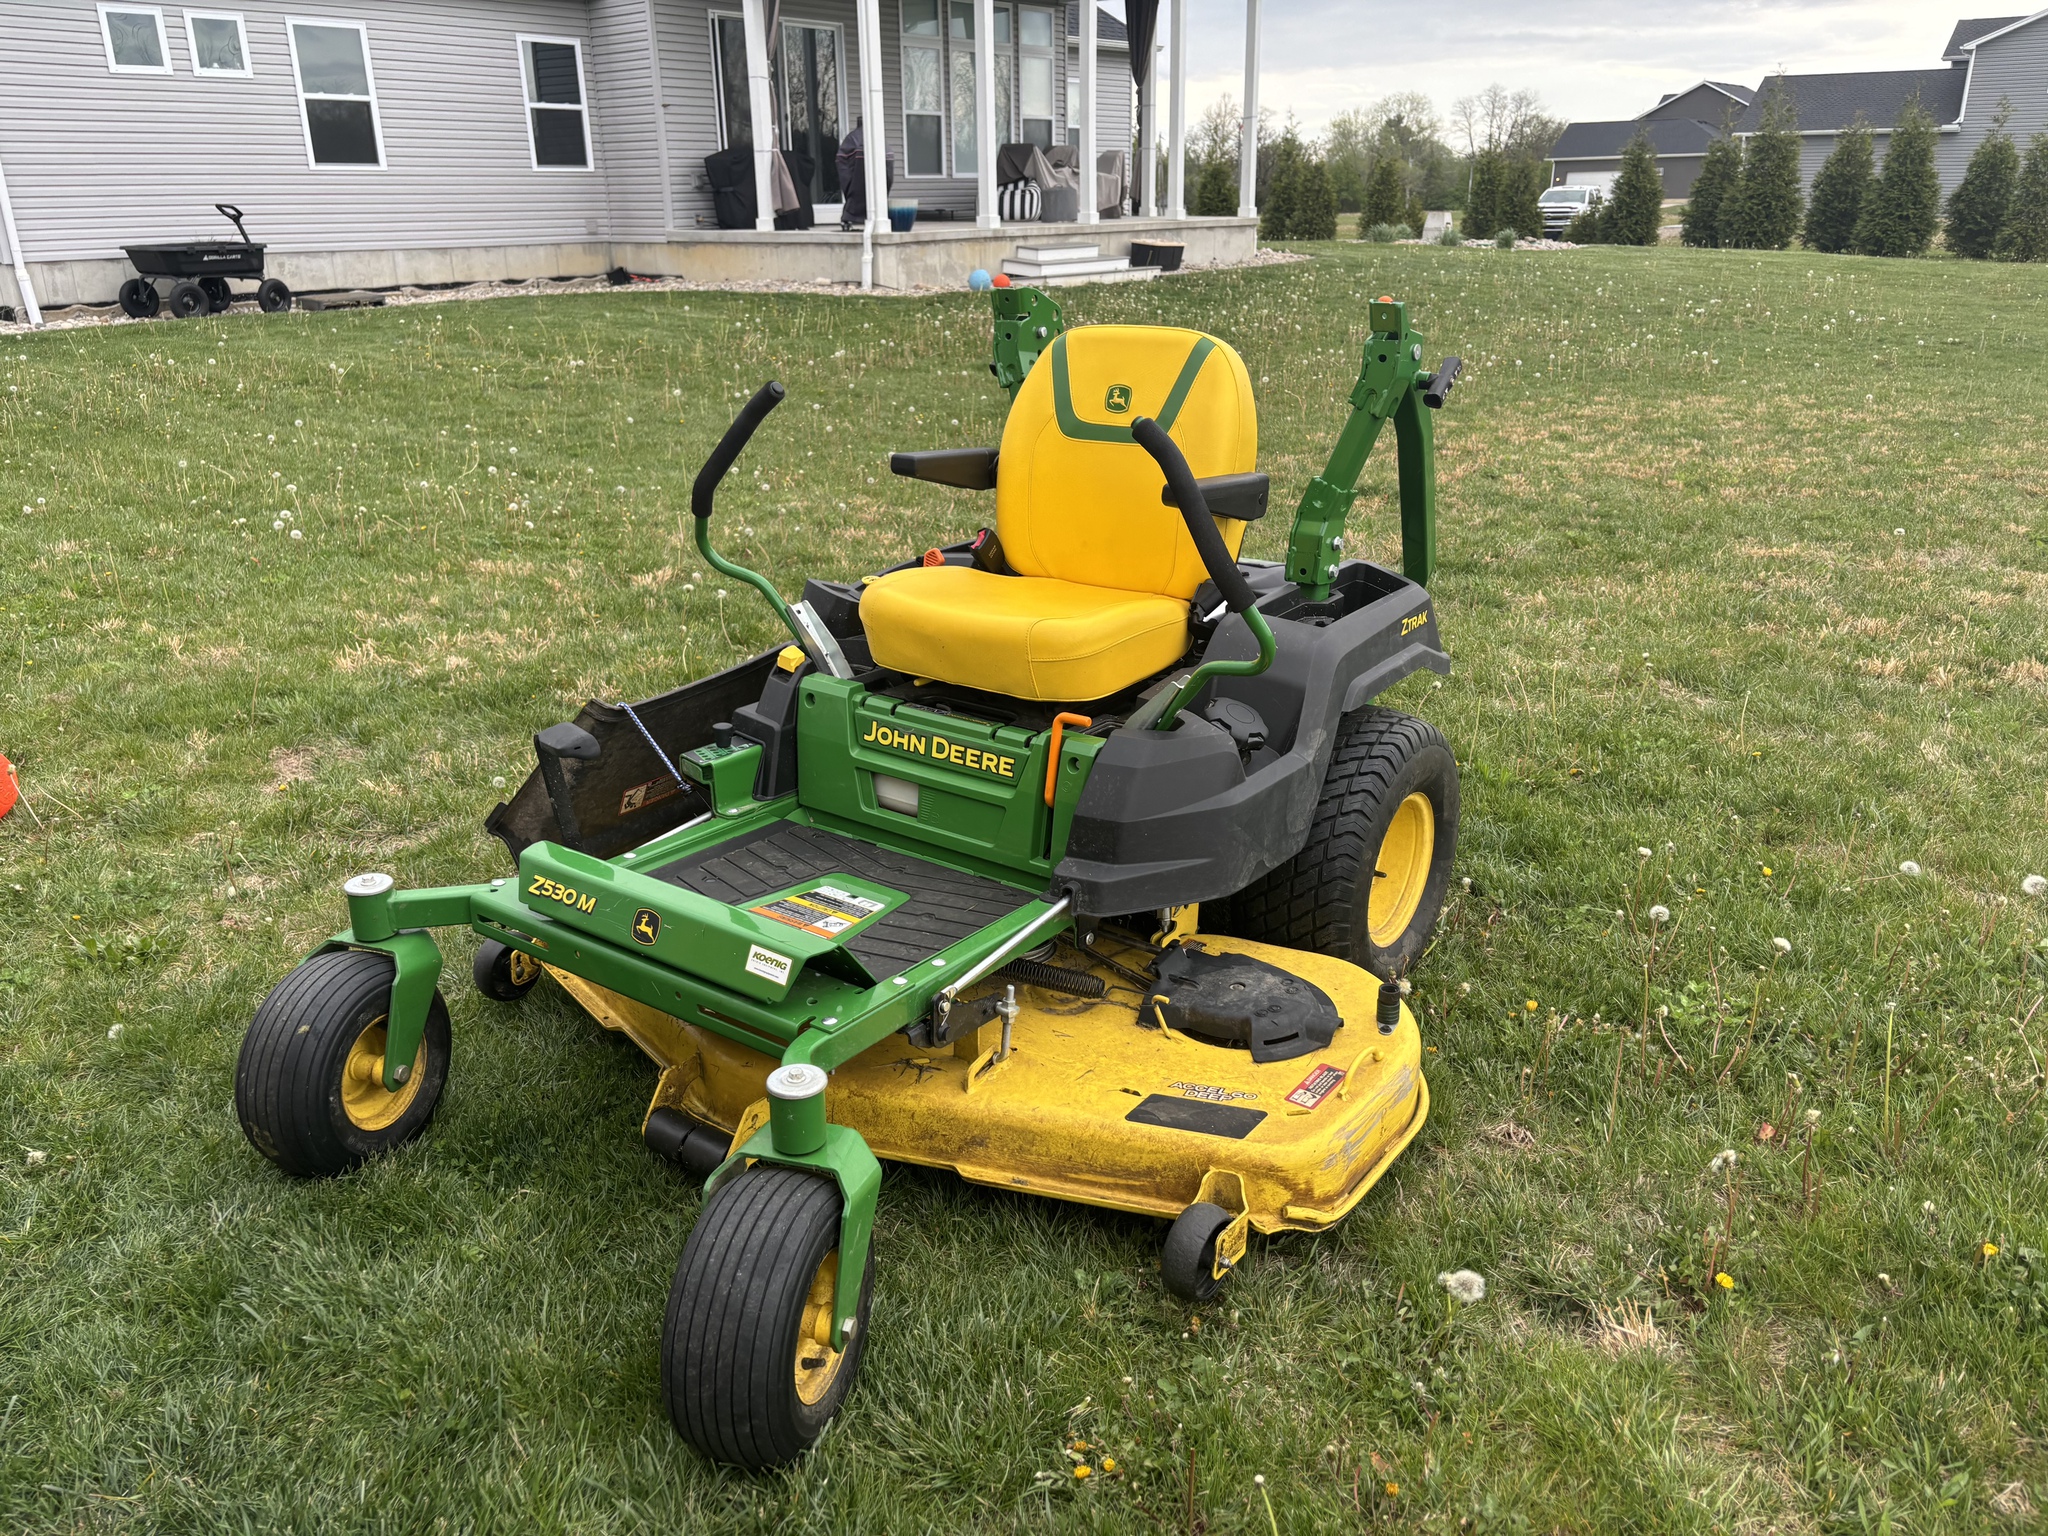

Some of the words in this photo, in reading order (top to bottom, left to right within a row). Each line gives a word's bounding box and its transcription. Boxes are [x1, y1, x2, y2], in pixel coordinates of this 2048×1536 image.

[1401, 610, 1428, 636] ZTRAK
[863, 721, 926, 755] JOHN
[931, 736, 1015, 778] DEERE
[528, 874, 577, 905] Z530
[576, 893, 597, 914] M
[1168, 1081, 1226, 1095] ACCEL
[1183, 1089, 1233, 1101] DEEP
[1231, 1091, 1258, 1100] 60
